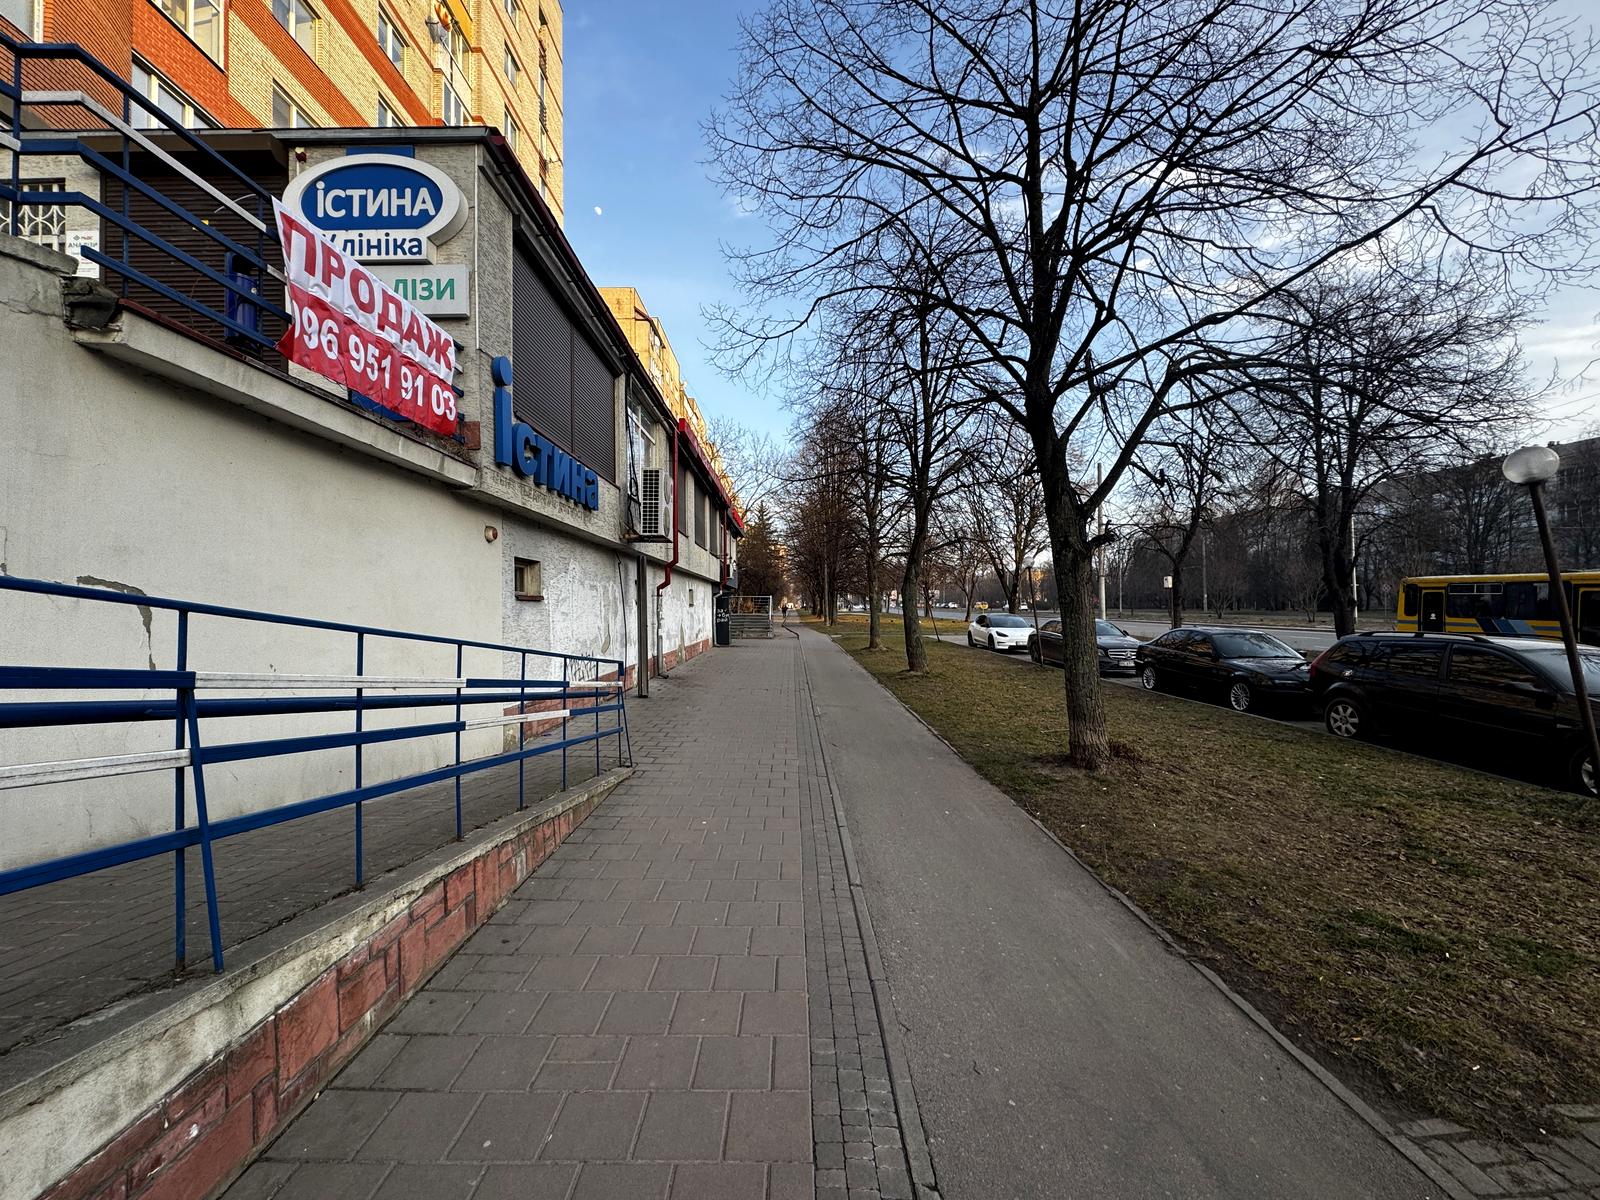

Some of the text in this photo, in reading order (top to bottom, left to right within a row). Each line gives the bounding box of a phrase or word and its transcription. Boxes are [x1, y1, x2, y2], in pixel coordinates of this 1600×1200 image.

[279, 210, 453, 372] ПРОДАЖ
[348, 334, 391, 389] 951
[401, 368, 424, 406] 91
[431, 384, 456, 421] 03
